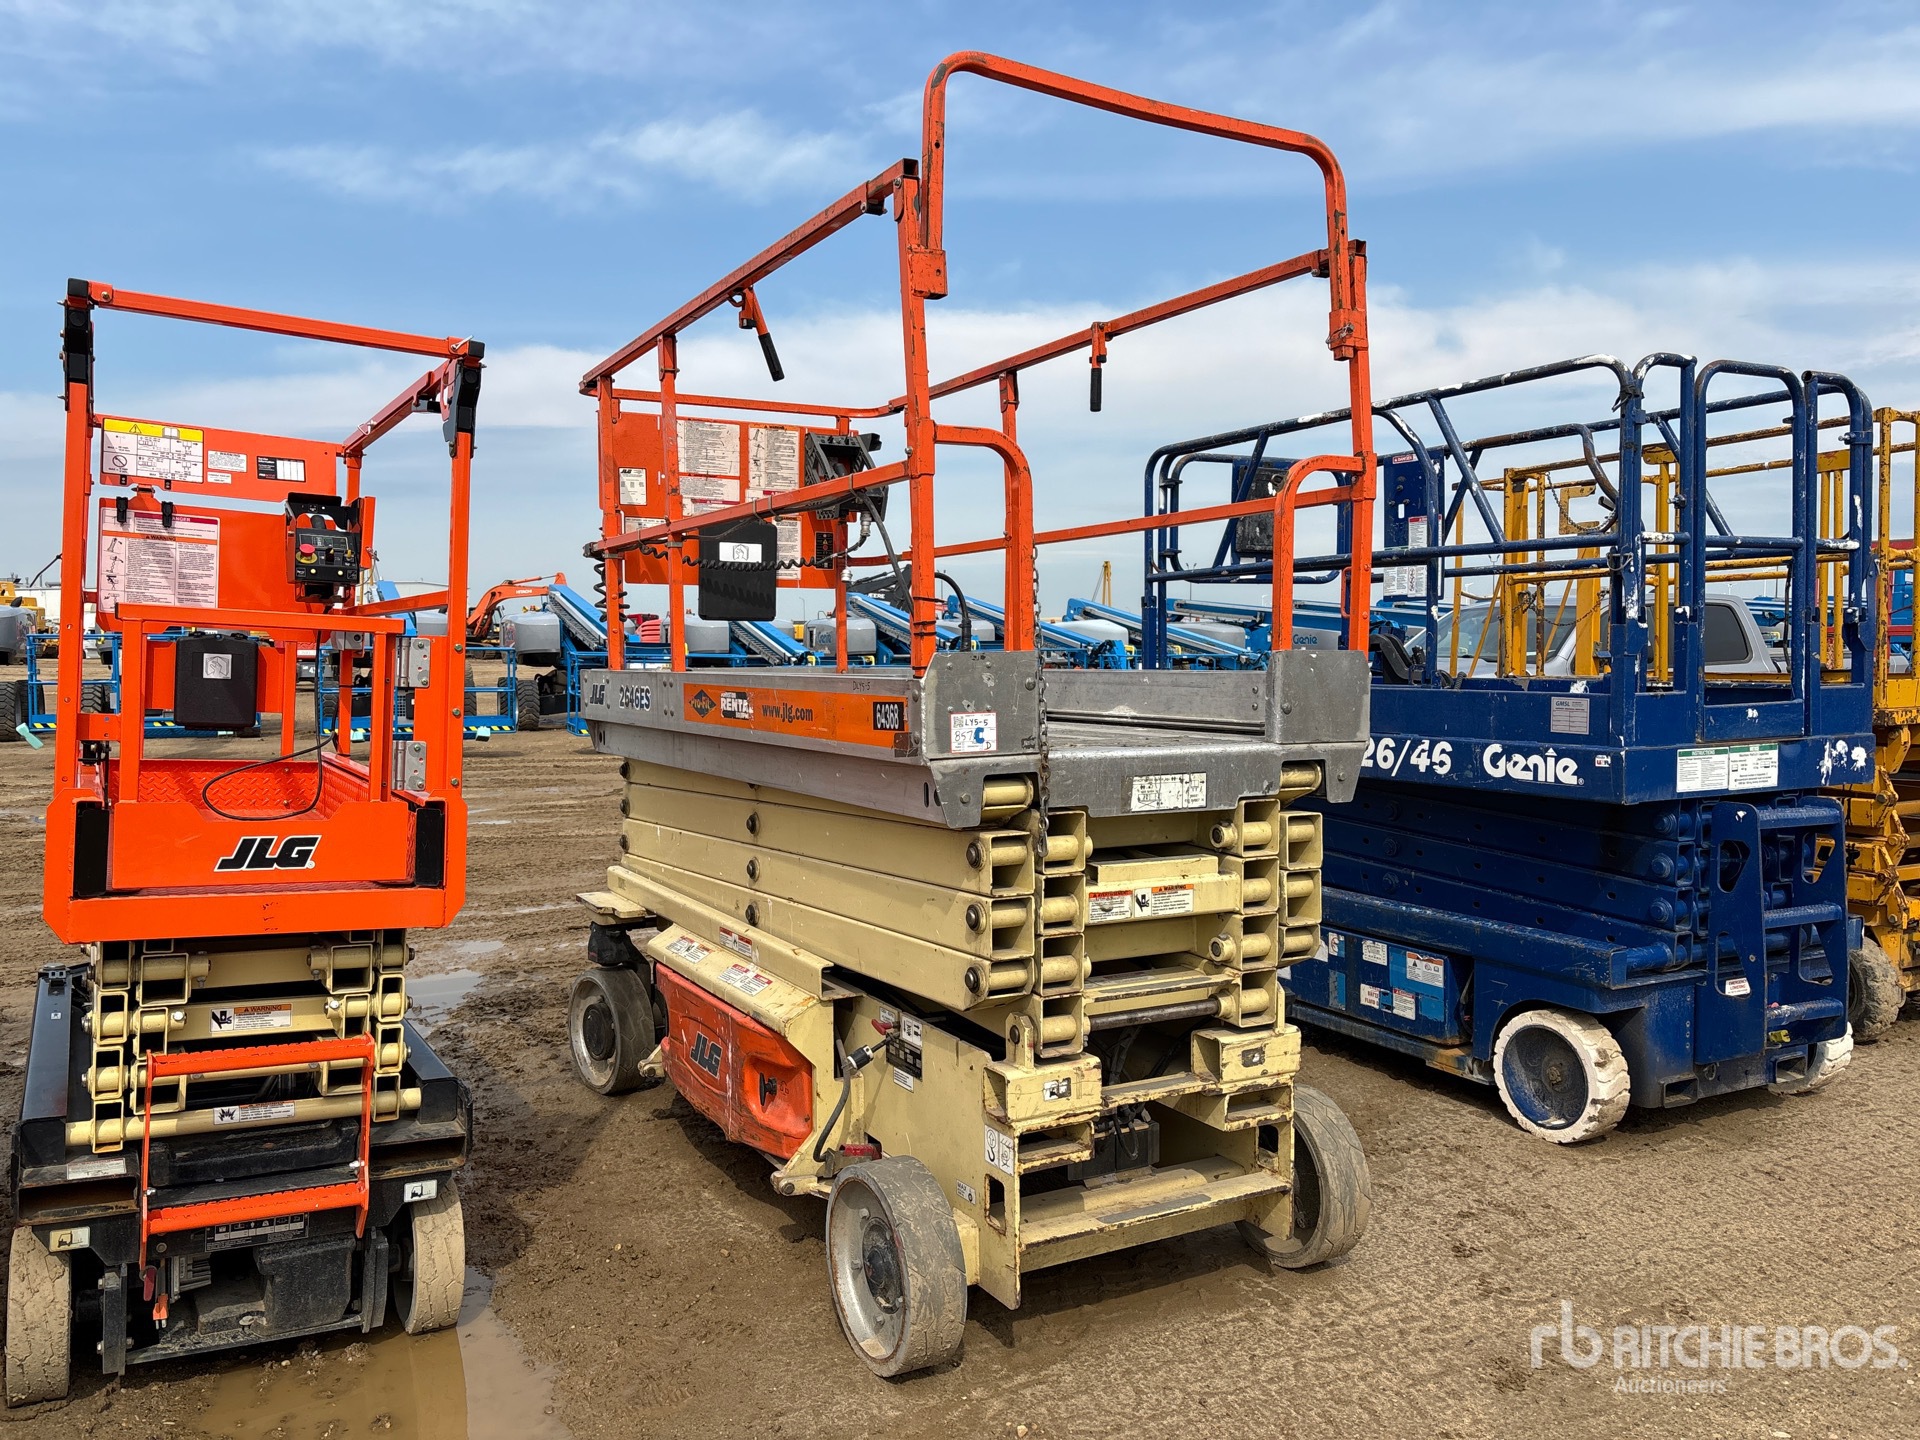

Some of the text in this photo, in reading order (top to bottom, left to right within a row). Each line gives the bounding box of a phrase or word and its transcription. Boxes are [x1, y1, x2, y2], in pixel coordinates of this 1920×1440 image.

[1293, 634, 1317, 644] Genie
[590, 684, 605, 704] JLG
[619, 685, 651, 711] 2646ES
[762, 703, 814, 723] www.jlg.com
[876, 703, 899, 729] 64368
[1483, 743, 1578, 785] Genie
[213, 835, 322, 872] JLG
[690, 1031, 723, 1079] JLG
